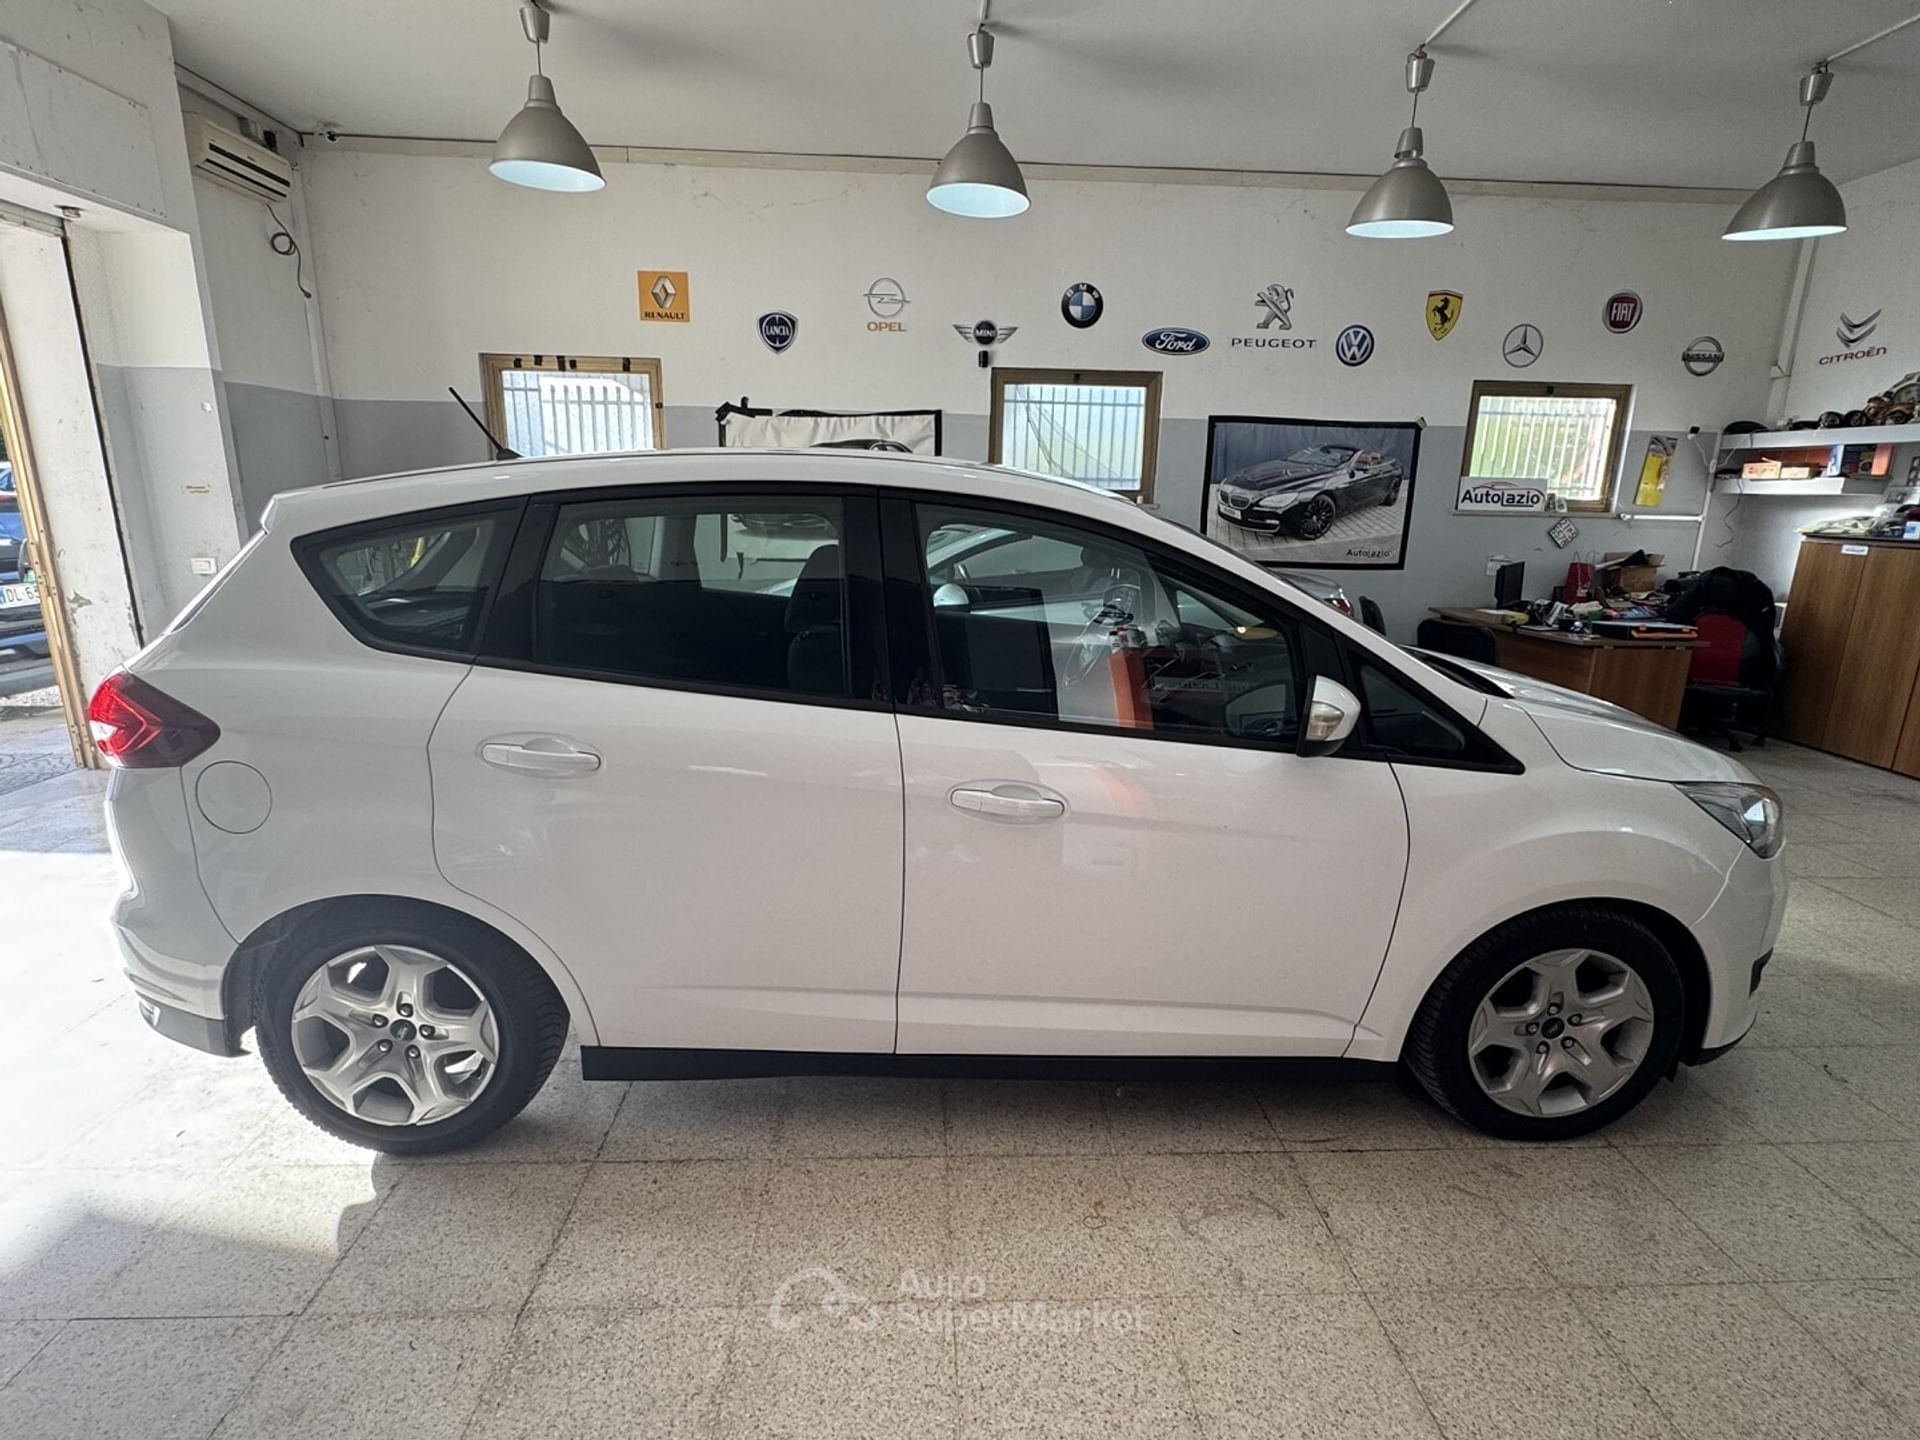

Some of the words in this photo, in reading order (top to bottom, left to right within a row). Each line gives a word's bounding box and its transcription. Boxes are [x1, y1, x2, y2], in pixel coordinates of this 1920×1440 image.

[644, 311, 685, 320] RENAULT
[1611, 302, 1634, 322] FIAT
[766, 325, 789, 337] LANCIA
[867, 321, 905, 332] OPEL
[976, 329, 995, 338] MINI
[1155, 331, 1196, 351] Ford
[1231, 337, 1316, 350] PEUGEOT
[1686, 352, 1721, 362] NISSAN
